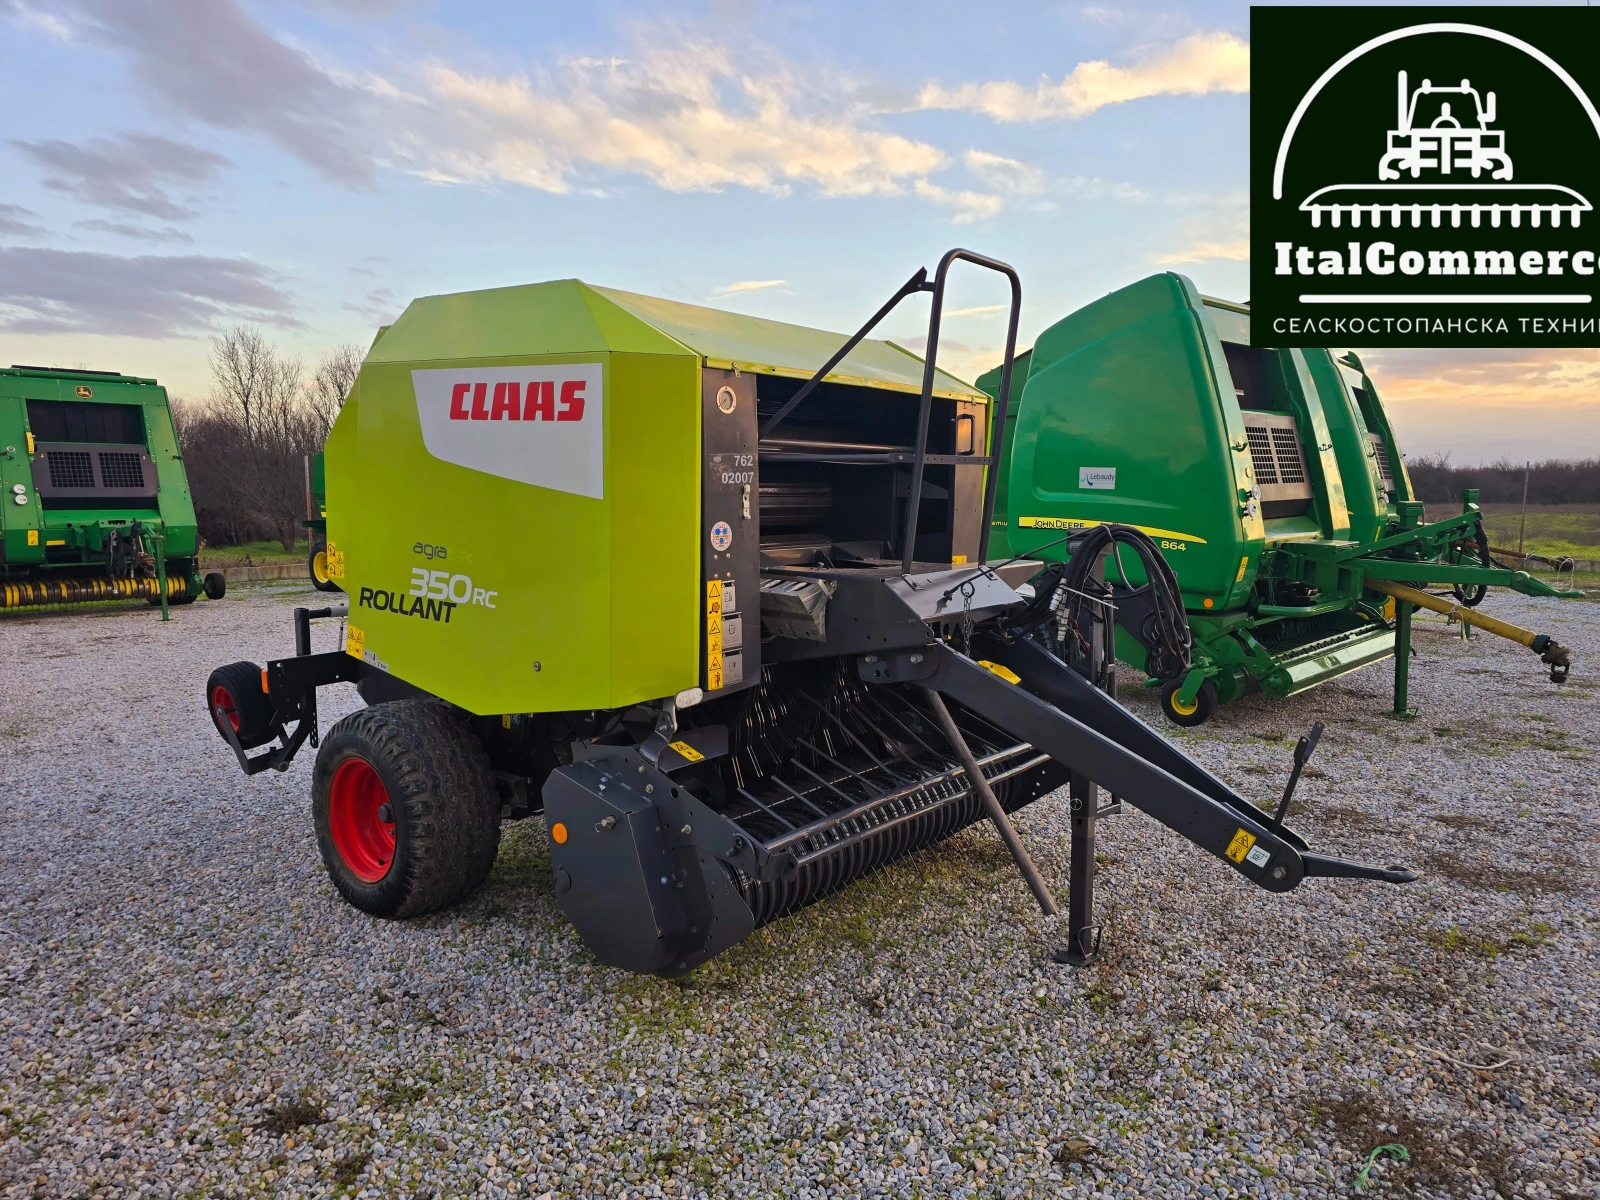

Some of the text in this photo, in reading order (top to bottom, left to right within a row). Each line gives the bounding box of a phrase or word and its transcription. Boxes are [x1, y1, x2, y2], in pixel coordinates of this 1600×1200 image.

[449, 380, 587, 422] CLAAS
[734, 455, 753, 467] 762
[721, 472, 755, 484] 02007
[1090, 473, 1115, 481] Lebaudy
[1032, 519, 1085, 530] JOHN DEERE
[1161, 541, 1187, 552] 864
[409, 567, 498, 609] 350 RC
[358, 586, 457, 623] ROLLANT
